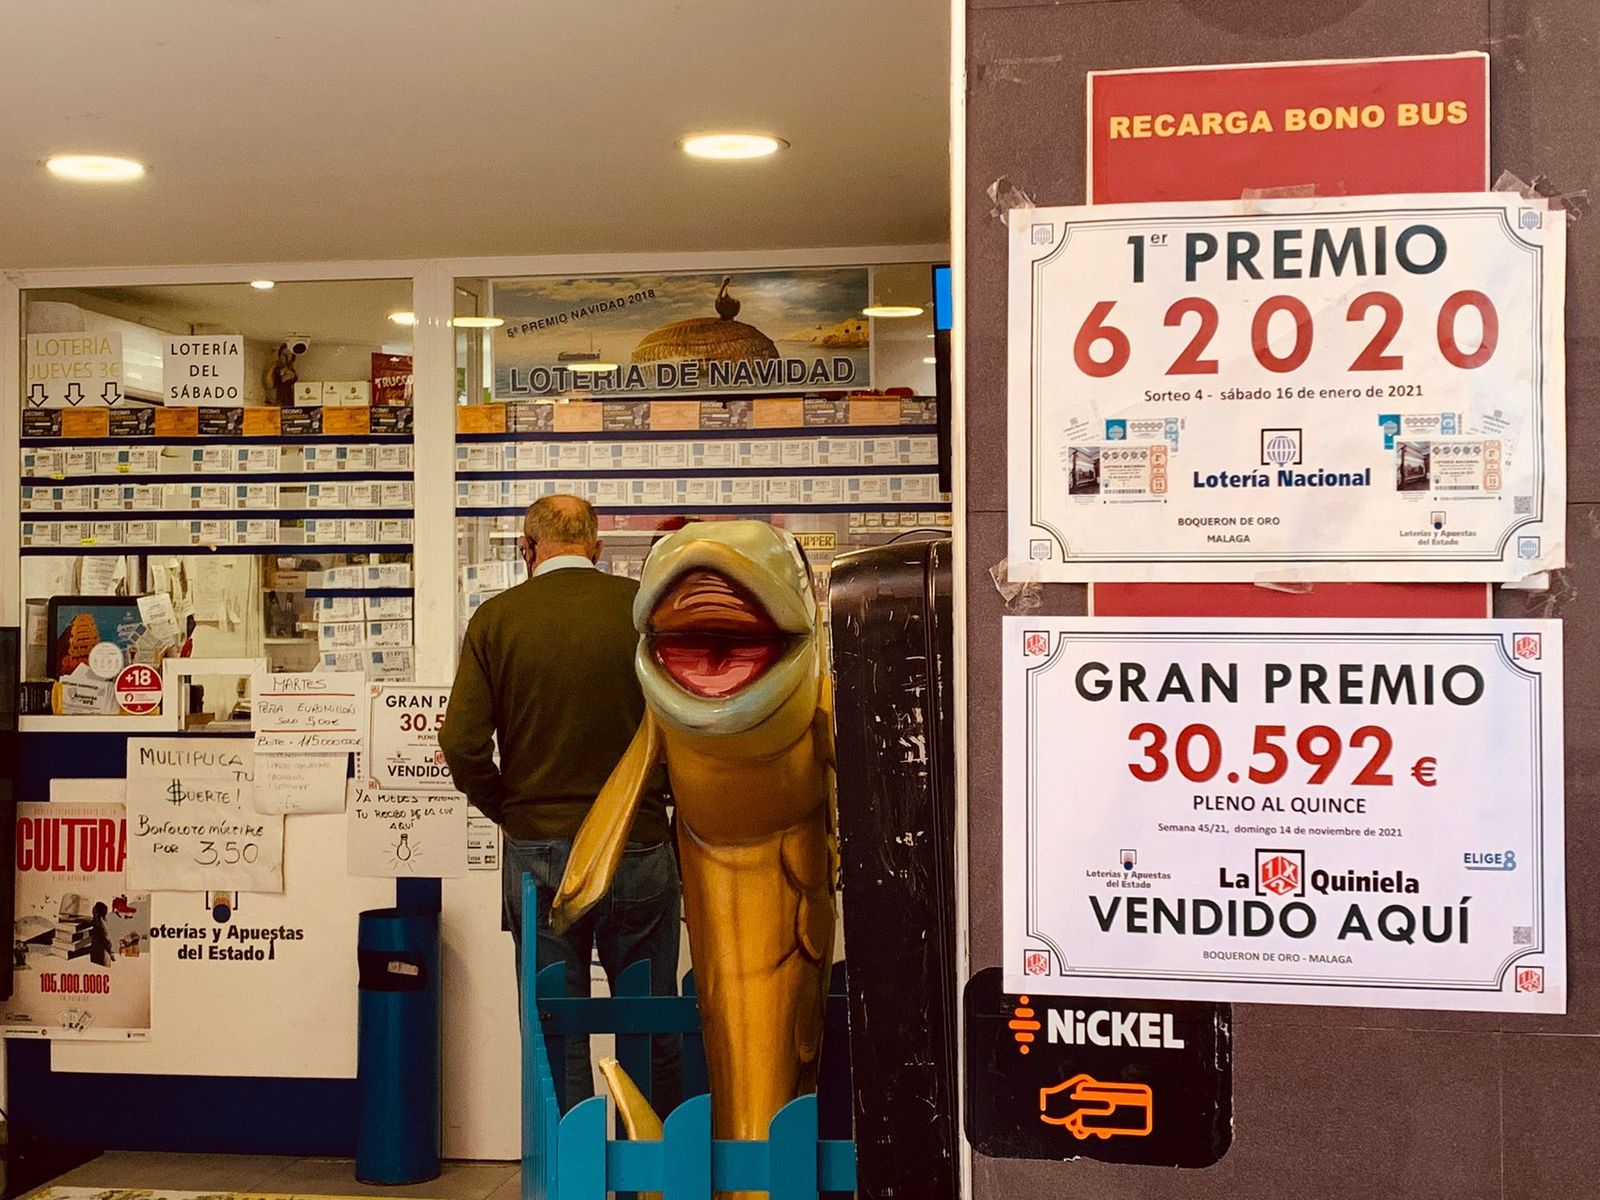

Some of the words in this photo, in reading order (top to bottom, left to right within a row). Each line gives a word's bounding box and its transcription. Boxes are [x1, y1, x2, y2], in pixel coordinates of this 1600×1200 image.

[1110, 109, 1274, 139] RECARGA
[1284, 105, 1385, 133] BONO
[1397, 100, 1469, 127] BUS
[1126, 230, 1169, 284] 1er
[1184, 224, 1448, 283] PREMIO
[521, 313, 568, 335] PREMIO
[570, 297, 626, 320] NAVIDAD
[628, 289, 657, 305] 2018
[35, 335, 113, 357] LOTERÍA
[170, 341, 239, 356] LOTERÍA
[29, 361, 94, 380] JUEVES
[99, 361, 121, 379] 3€
[189, 365, 219, 378] DEL
[509, 362, 648, 394] LOTERIA
[655, 360, 700, 389] DE
[709, 356, 856, 387] NAVIDAD
[170, 383, 239, 400] SÁBADO
[1144, 387, 1191, 402] Sorteo
[1194, 388, 1204, 401] 4
[1219, 385, 1271, 401] sábado
[1275, 386, 1294, 400] 16
[1296, 385, 1316, 399] de
[1319, 387, 1363, 399] enero
[1366, 384, 1384, 399] de
[1387, 384, 1424, 398] 2021
[1193, 467, 1271, 488] Lotería
[1277, 467, 1371, 488] Nacional
[1177, 517, 1237, 528] BOQUERON
[1240, 517, 1254, 526] DE
[1257, 516, 1281, 526] ORO
[1207, 534, 1252, 544] MALAGA
[1432, 538, 1459, 546] Estado
[1440, 529, 1477, 538] Apuestas
[125, 669, 152, 687] +18
[273, 676, 327, 692] MARTES
[1075, 661, 1239, 703] GRAN
[1264, 663, 1486, 706] PREMIO
[385, 695, 433, 709] GRAN
[1127, 722, 1394, 787] 30.592
[1410, 757, 1438, 788] €
[232, 770, 254, 783] TU
[355, 788, 372, 803] YA
[1192, 795, 1257, 812] PLENO
[1262, 796, 1286, 813] AL
[1290, 797, 1367, 815] QUINCE
[356, 809, 368, 820] TU
[1158, 823, 1196, 833] Semana
[1197, 823, 1231, 835] 45/21,
[1234, 824, 1277, 838] domingo
[1279, 826, 1292, 835] 14
[1294, 825, 1307, 836] de
[1309, 826, 1361, 837] noviembre
[1363, 826, 1376, 837] de
[1378, 827, 1403, 838] 2021
[153, 842, 179, 854] POR
[194, 840, 260, 867] 3,50
[1086, 870, 1122, 878] Loterías
[1123, 872, 1129, 880] y
[1131, 871, 1172, 880] Apuestas
[1219, 867, 1250, 889] La
[1311, 866, 1420, 895] Quiniela
[1106, 880, 1119, 888] del
[1121, 881, 1151, 889] Estado
[1088, 895, 1318, 939] VENDIDO
[1337, 896, 1473, 945] AQUÍ
[150, 922, 207, 939] oterías
[212, 927, 222, 943] y
[226, 924, 304, 944] Apuestas
[177, 944, 203, 960] del
[208, 945, 265, 961] Estado
[1202, 950, 1261, 963] BOQUERON
[1262, 952, 1275, 962] DE
[1276, 952, 1301, 963] ORO
[1308, 954, 1353, 965] MALAGA
[1047, 1009, 1186, 1049] NiCKEL
